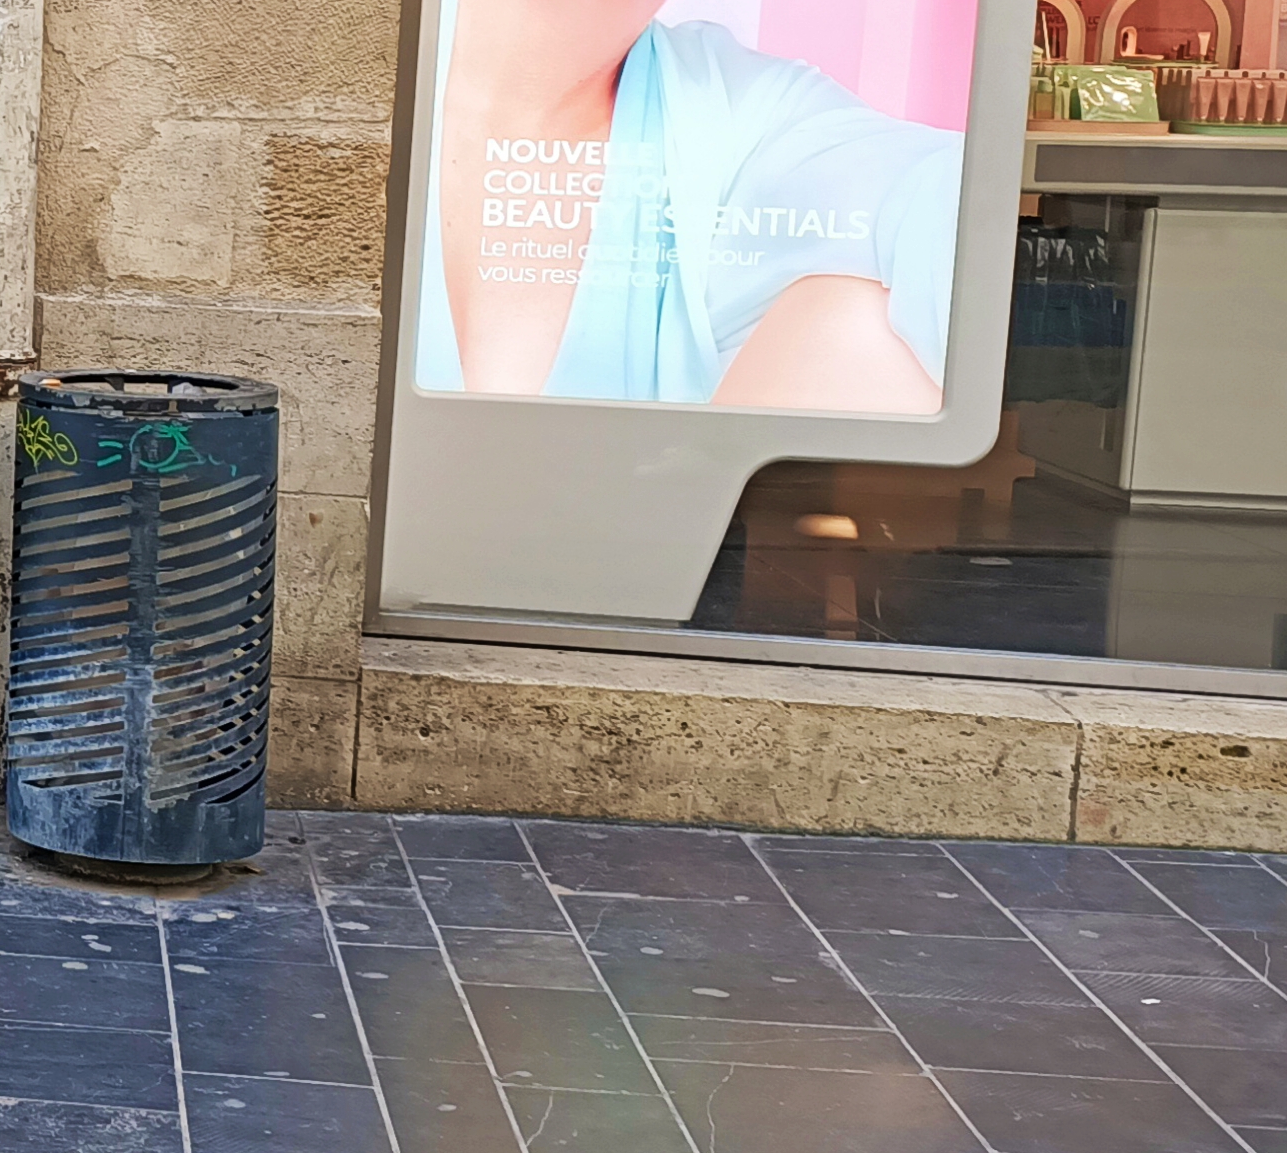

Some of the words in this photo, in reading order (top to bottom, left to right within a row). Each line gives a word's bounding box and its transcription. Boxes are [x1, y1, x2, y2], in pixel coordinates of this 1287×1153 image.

[483, 169, 679, 200] COLLECTIO
[640, 203, 871, 241] ESENTIALS
[480, 236, 506, 258] Le
[511, 236, 572, 259] rituel
[477, 264, 536, 284] vous
